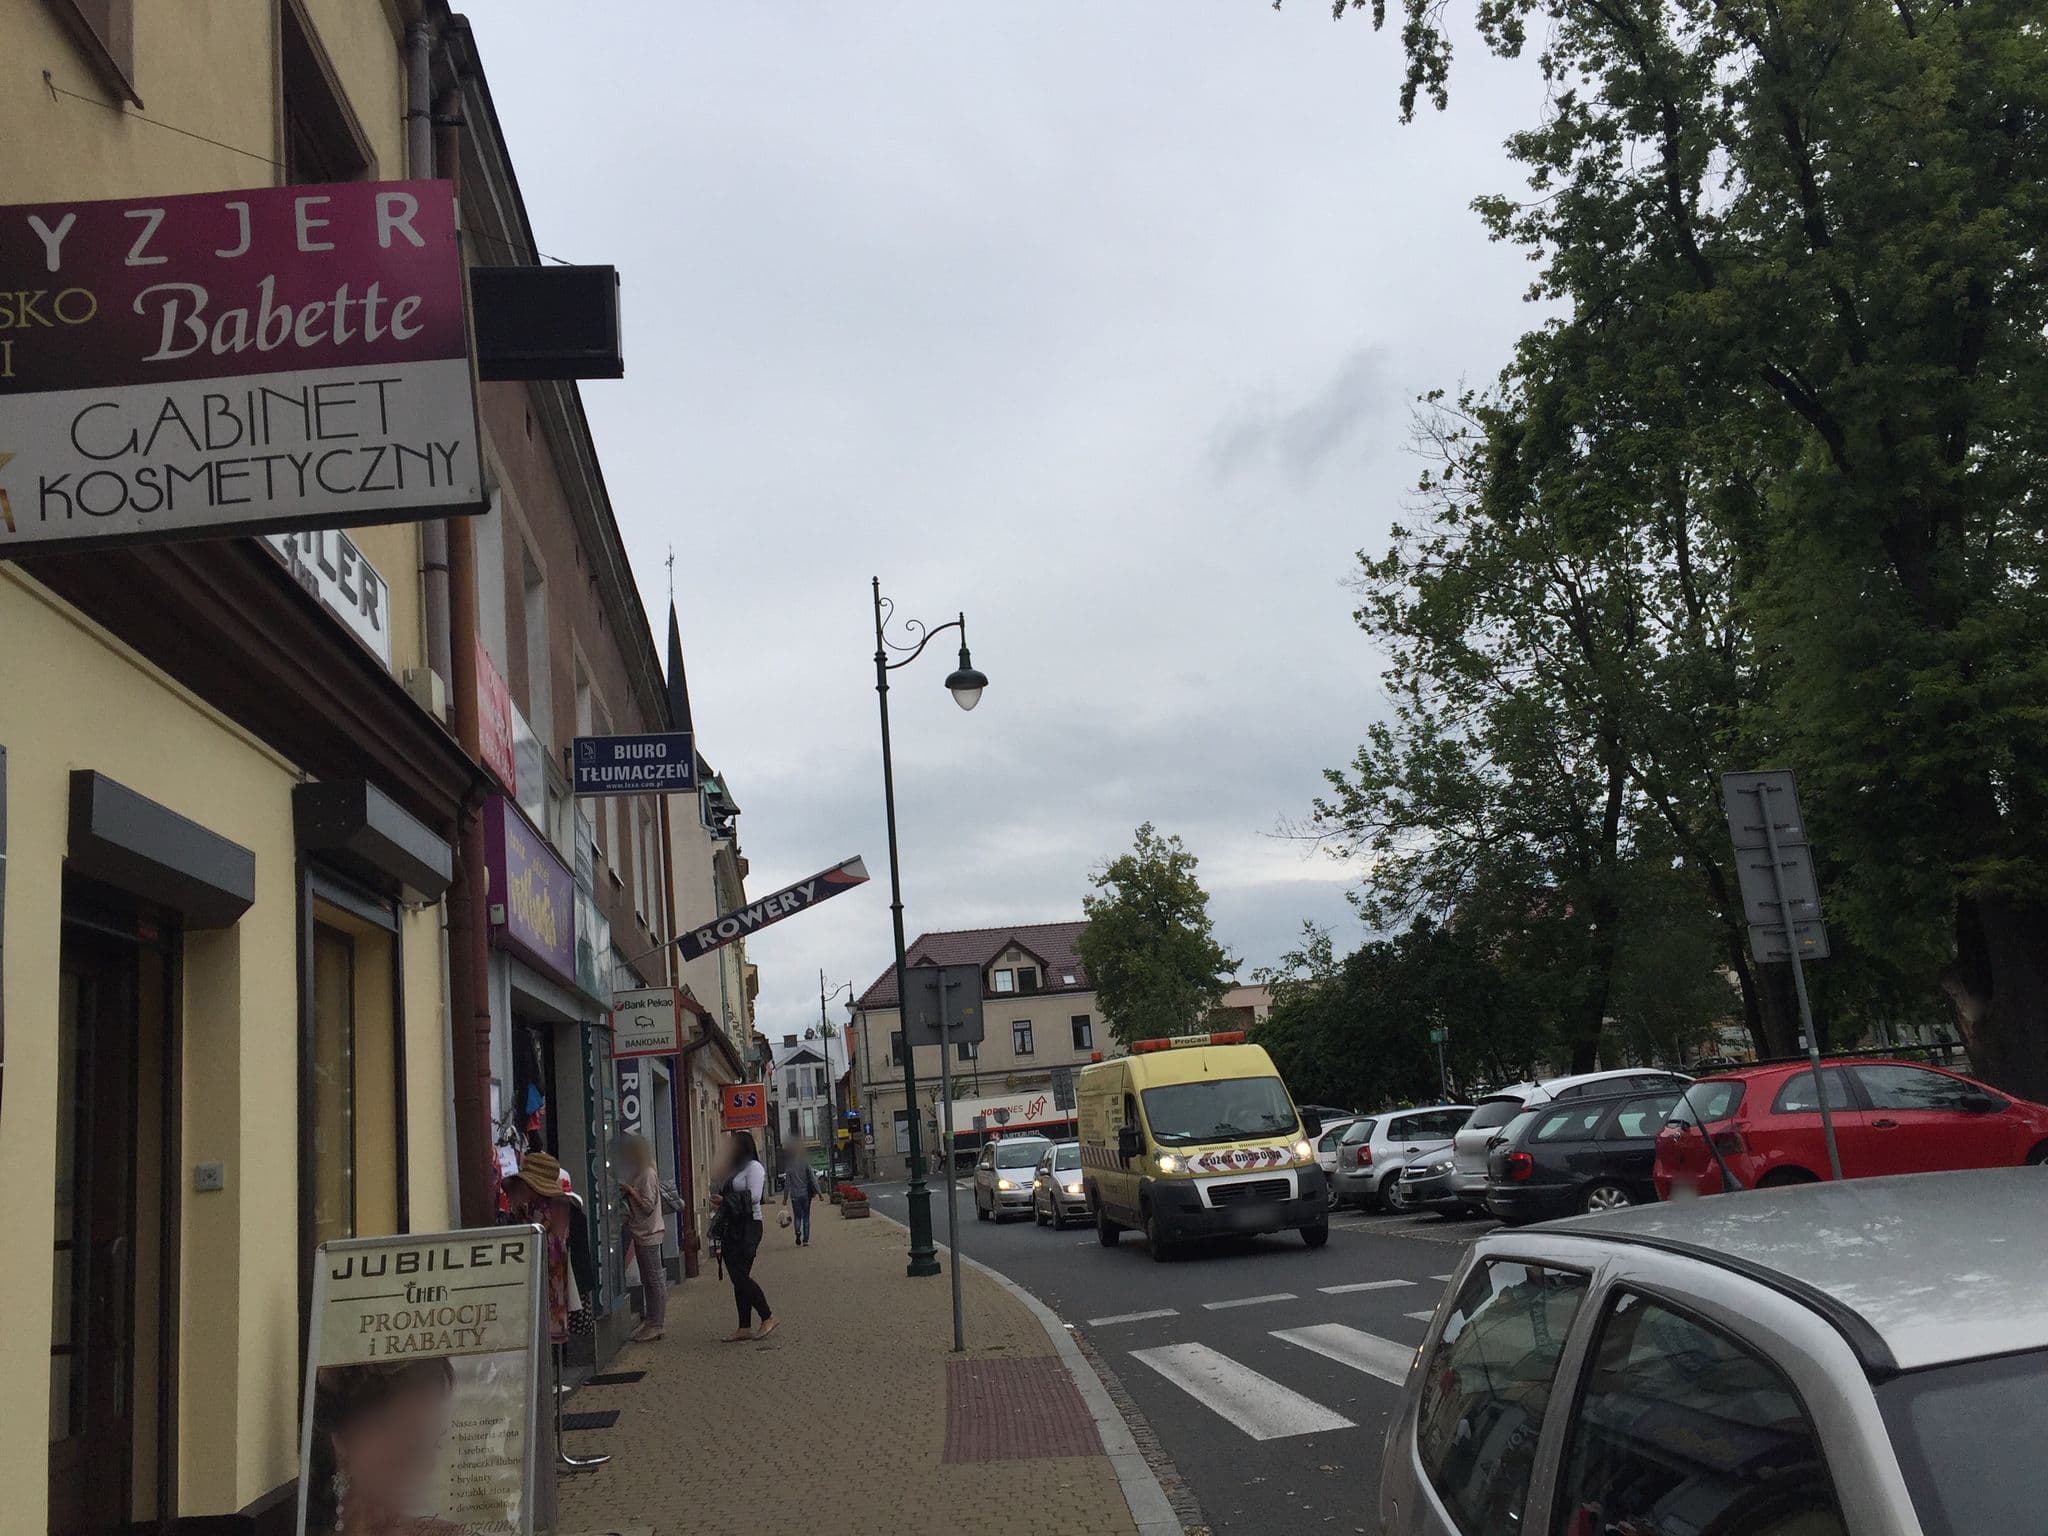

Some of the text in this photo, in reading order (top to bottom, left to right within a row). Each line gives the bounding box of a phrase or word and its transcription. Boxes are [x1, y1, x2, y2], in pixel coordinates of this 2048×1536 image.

[133, 274, 425, 363] Babette
[71, 378, 403, 461] GABINET
[39, 440, 460, 522] KOSMETYCZNY
[614, 743, 667, 760] BIURO
[580, 760, 689, 782] TŁUMACZEŃ
[696, 880, 815, 950] ROWERY
[624, 998, 674, 1010] Bank Pekao
[625, 1036, 670, 1049] BANKOMAT
[332, 1242, 526, 1280] JUBILER
[359, 1303, 498, 1333] PROMOCJE
[368, 1327, 488, 1356] i RABATY
